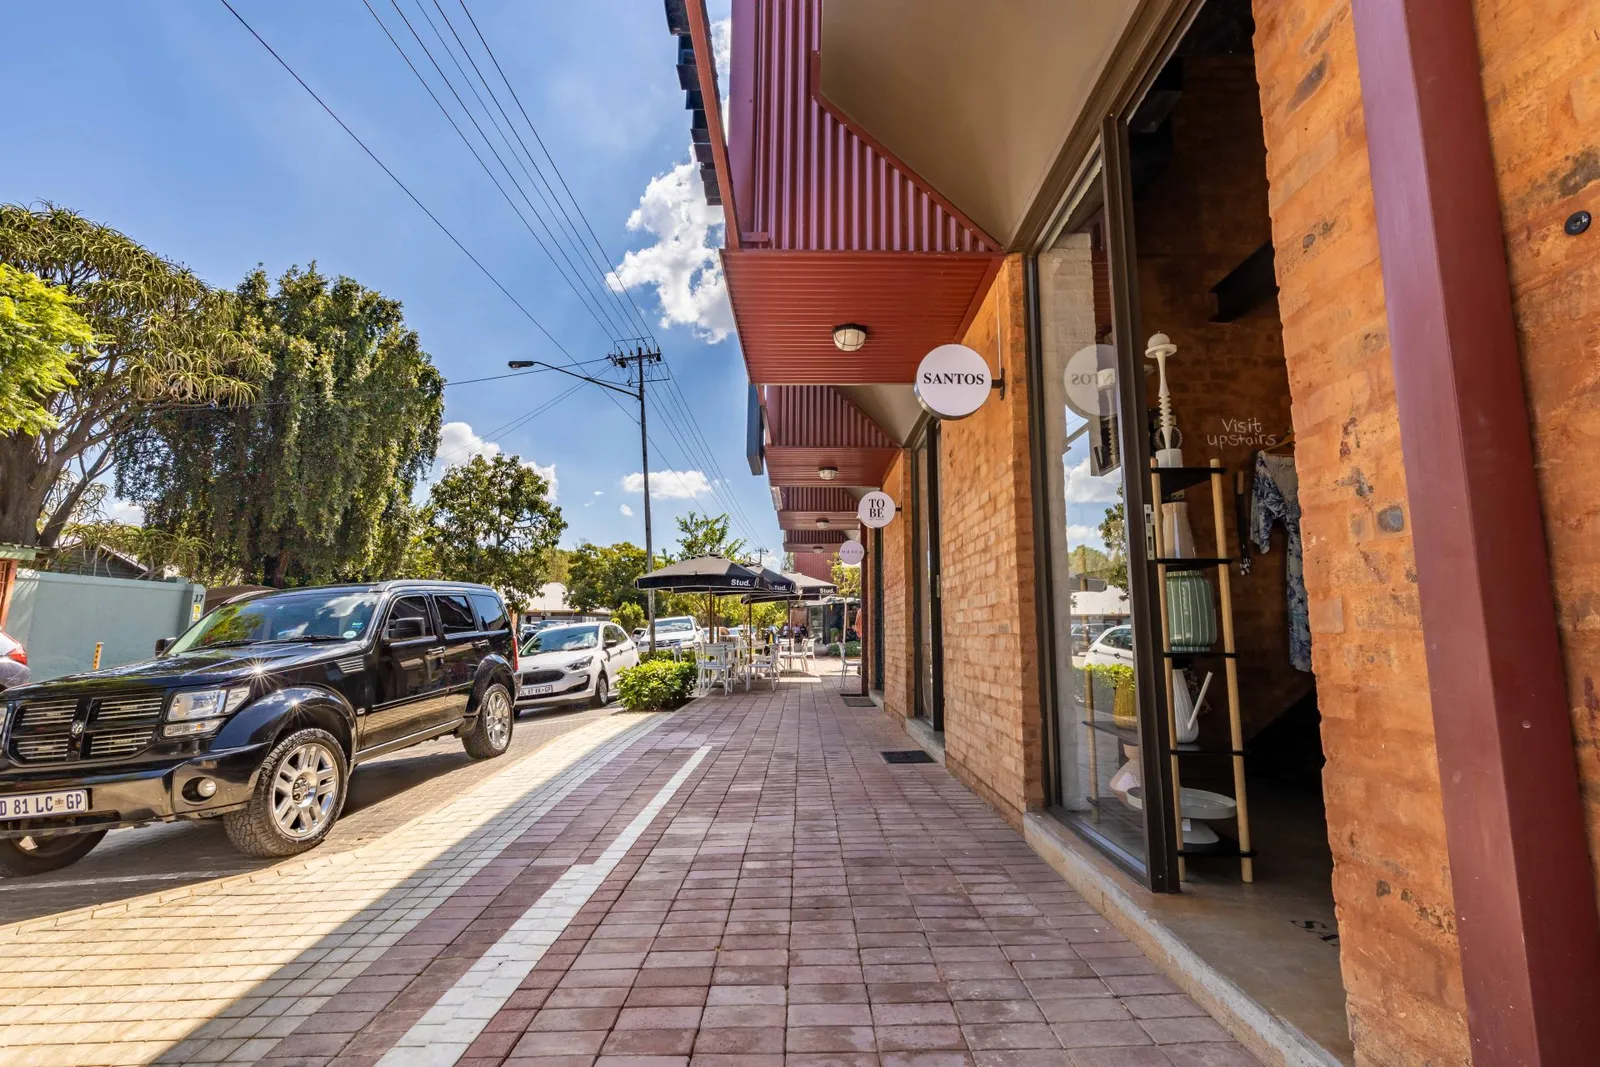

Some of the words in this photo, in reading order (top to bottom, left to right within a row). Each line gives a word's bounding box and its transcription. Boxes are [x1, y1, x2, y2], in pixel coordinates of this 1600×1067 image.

[923, 372, 985, 386] SANTOS
[1221, 417, 1262, 433] Visit
[868, 498, 886, 509] TO
[869, 508, 885, 518] BE
[730, 578, 751, 587] Stud.
[193, 594, 204, 603] 17
[14, 799, 30, 815] 81
[36, 796, 54, 813] LC
[66, 794, 82, 810] GP
